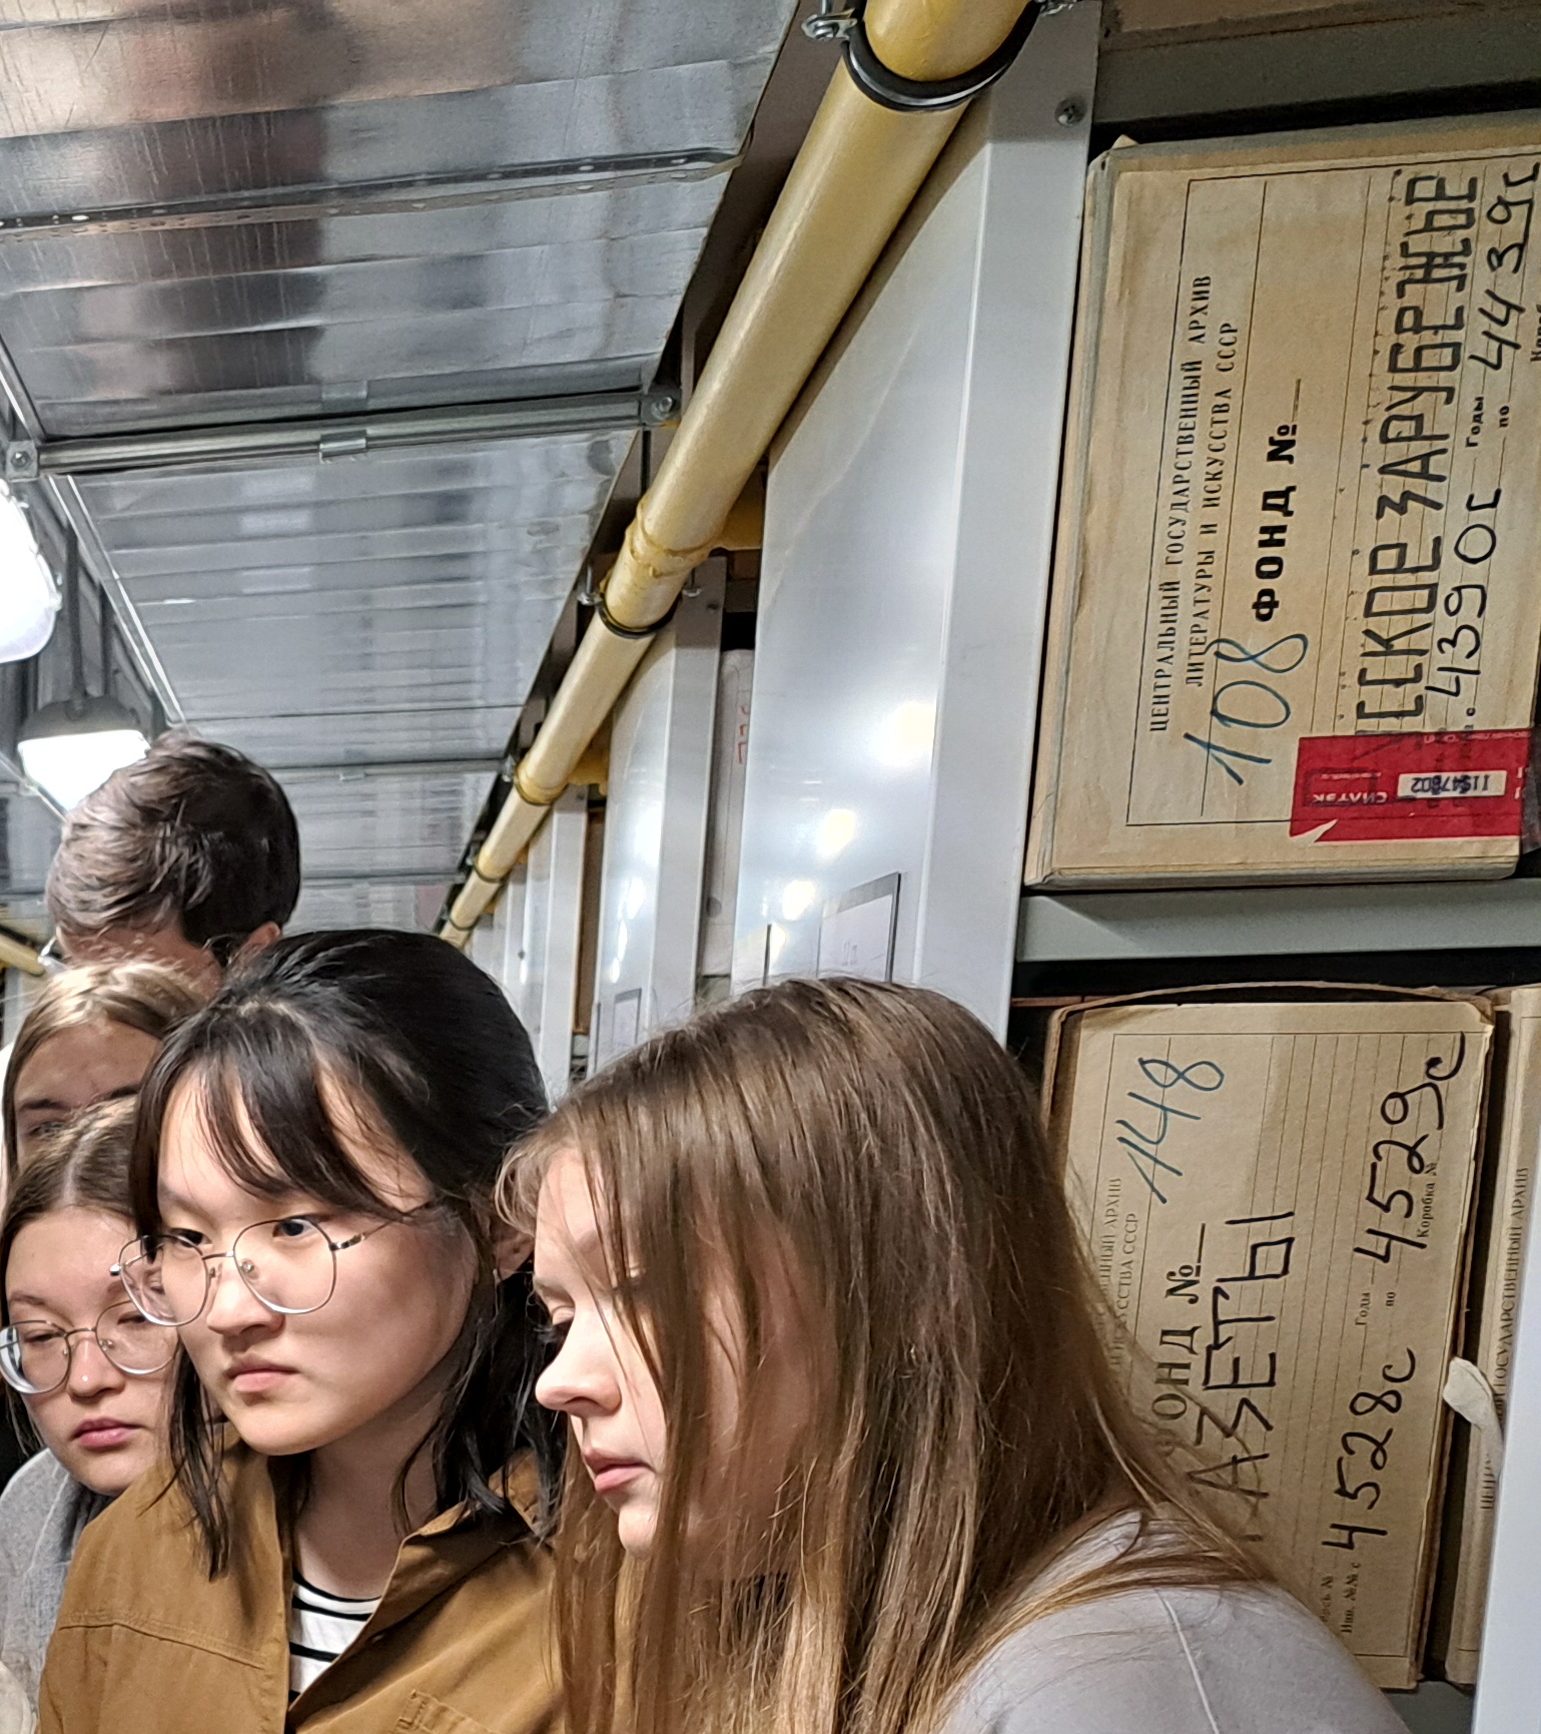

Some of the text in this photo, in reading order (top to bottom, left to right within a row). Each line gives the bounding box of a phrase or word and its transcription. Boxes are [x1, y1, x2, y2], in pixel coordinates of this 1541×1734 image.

[1465, 396, 1485, 448] Годы
[1149, 275, 1212, 732] ЦЕНТРАЛЬНЫЙ ГОСУДАРСТВЕННЫЙ АРХИВ
[1186, 322, 1238, 687] ЛИТЕРАТУРЫ И ИСКУССТВА СССР
[1251, 423, 1298, 622] ФОНД №
[1182, 633, 1309, 786] 108
[1313, 791, 1387, 804] СИЛТЭК
[1115, 1057, 1224, 1204] 148
[1123, 1213, 1139, 1250] СССР
[1416, 1181, 1437, 1238] Коробка
[1493, 1224, 1523, 1389] ГОСУДАРСТВЕННЫЙ
[1511, 1165, 1530, 1219] АРХИВ
